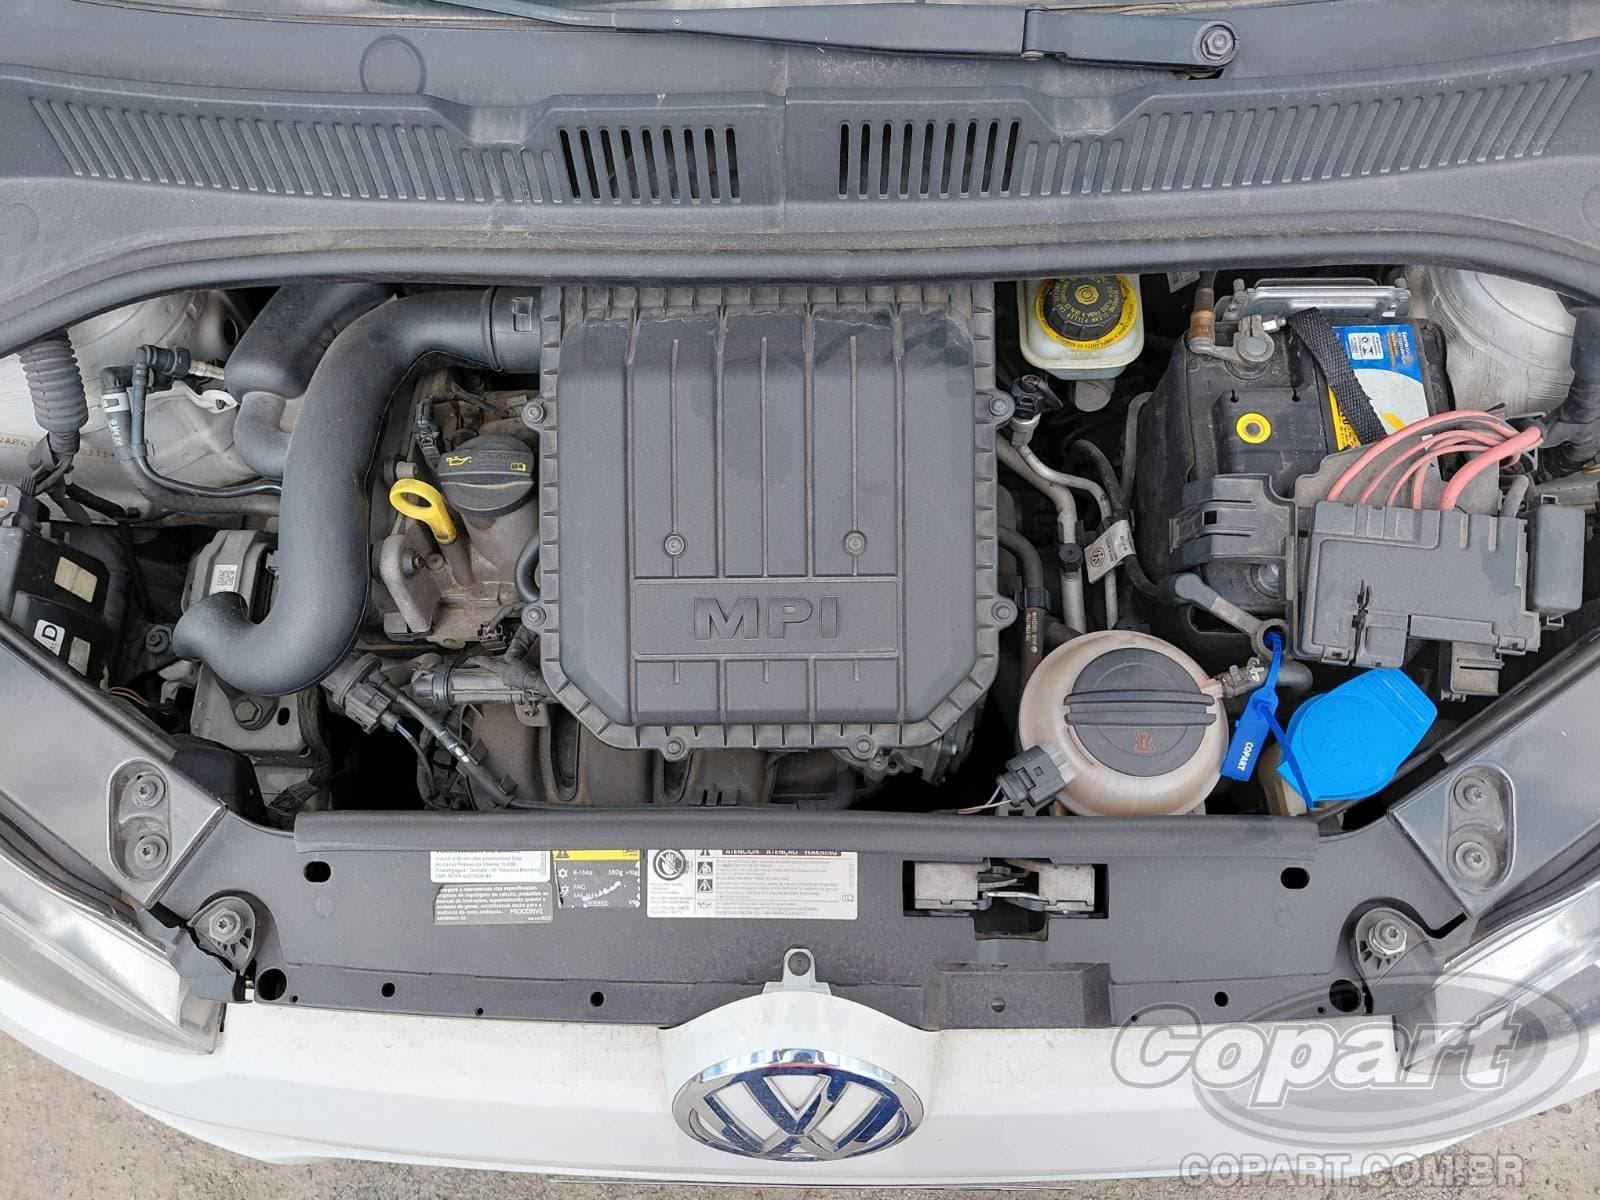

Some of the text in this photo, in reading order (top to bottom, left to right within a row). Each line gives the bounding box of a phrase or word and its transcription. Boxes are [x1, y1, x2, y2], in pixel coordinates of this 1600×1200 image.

[42, 624, 58, 642] D
[693, 596, 840, 640] MPI
[1237, 741, 1254, 772] COPART
